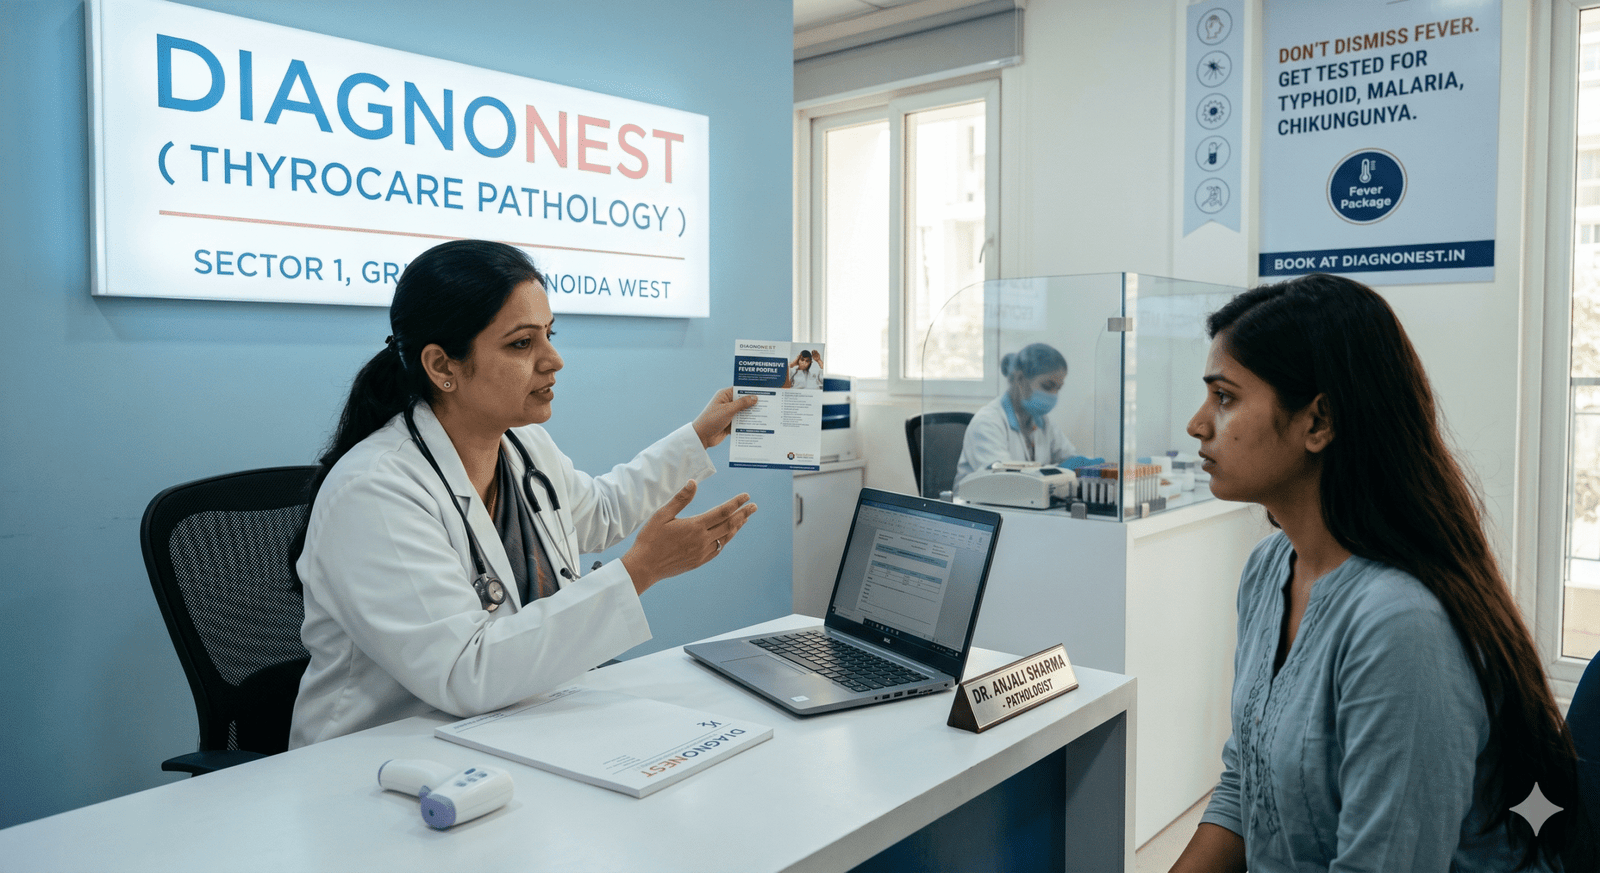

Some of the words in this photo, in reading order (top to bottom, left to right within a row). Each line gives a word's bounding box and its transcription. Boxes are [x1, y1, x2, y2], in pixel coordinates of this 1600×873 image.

[1279, 41, 1330, 63] DON'T
[1335, 27, 1408, 55] DISMISS
[1415, 17, 1480, 41] FEVER.
[1278, 68, 1312, 87] GET
[1316, 57, 1384, 82] TESTED
[1390, 50, 1428, 71] FOR
[156, 33, 684, 184] DIAGNONEST
[1278, 86, 1361, 111] TYPHOID,
[1368, 71, 1464, 100] MALARIA,
[1278, 104, 1417, 136] CHIKUNGUNYA.
[190, 144, 463, 210] THYROCARE
[477, 181, 670, 232] PATHOLOGY
[1341, 197, 1391, 209] Package
[1349, 185, 1383, 197] Fever
[193, 249, 323, 283] SECTOR
[333, 258, 351, 286] 1,
[545, 273, 611, 296] NOIDA
[618, 278, 672, 299] WEST
[1274, 256, 1316, 270] BOOK
[1319, 255, 1338, 268] AT
[1343, 249, 1466, 267] DIAGNONEST.IN
[972, 685, 993, 704] DR.
[992, 669, 1028, 696] ANJALI
[1026, 654, 1066, 680] SHARMA
[1005, 678, 1054, 708] PATHOLOGIST
[641, 728, 746, 778] DIAGNONEST
